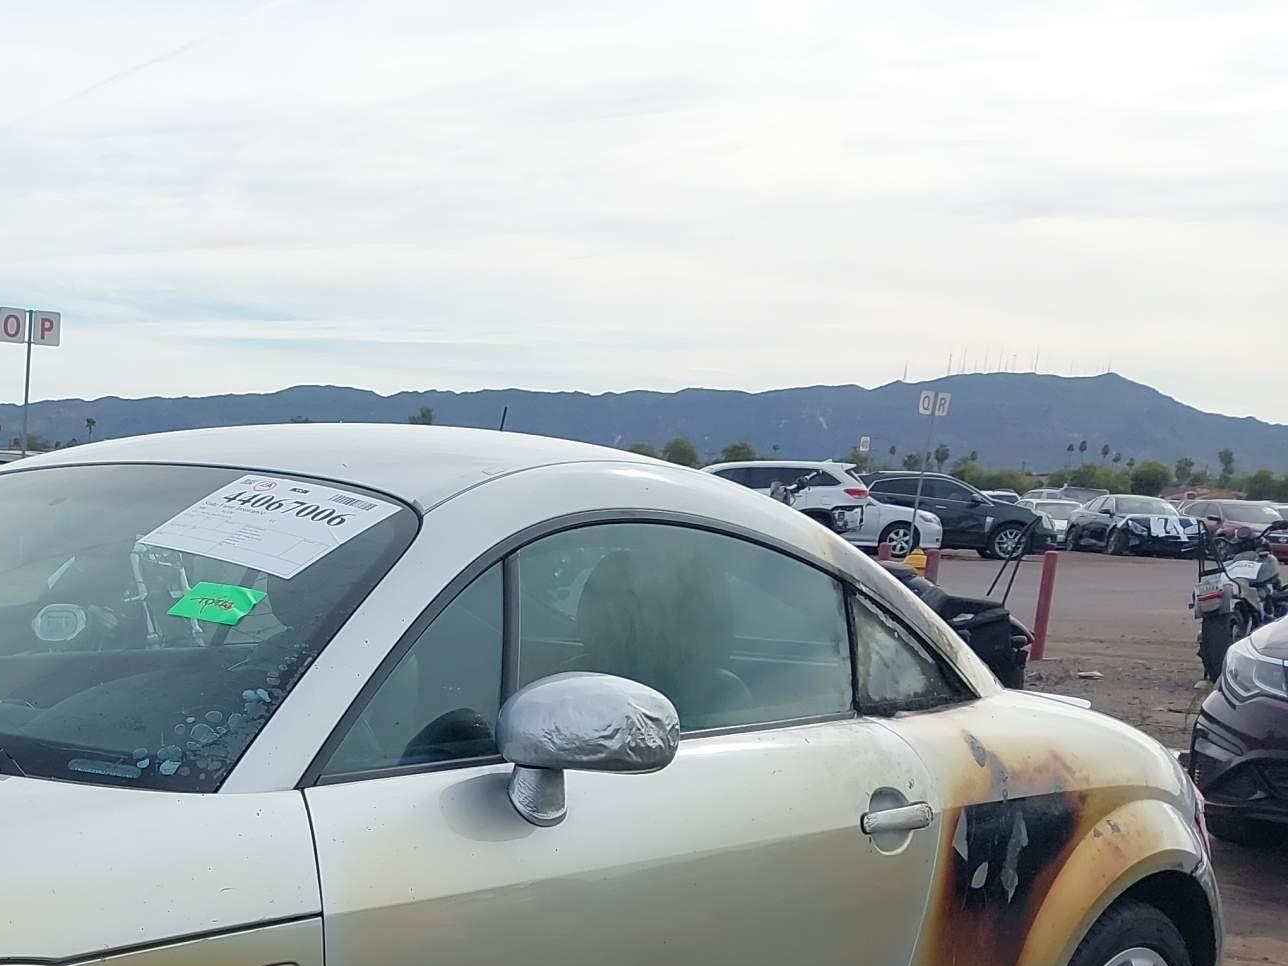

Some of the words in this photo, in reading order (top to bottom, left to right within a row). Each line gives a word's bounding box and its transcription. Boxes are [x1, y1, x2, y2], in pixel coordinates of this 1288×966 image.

[3, 314, 21, 338] O
[40, 317, 54, 340] P
[938, 397, 947, 413] R
[223, 491, 357, 527] 44067006
